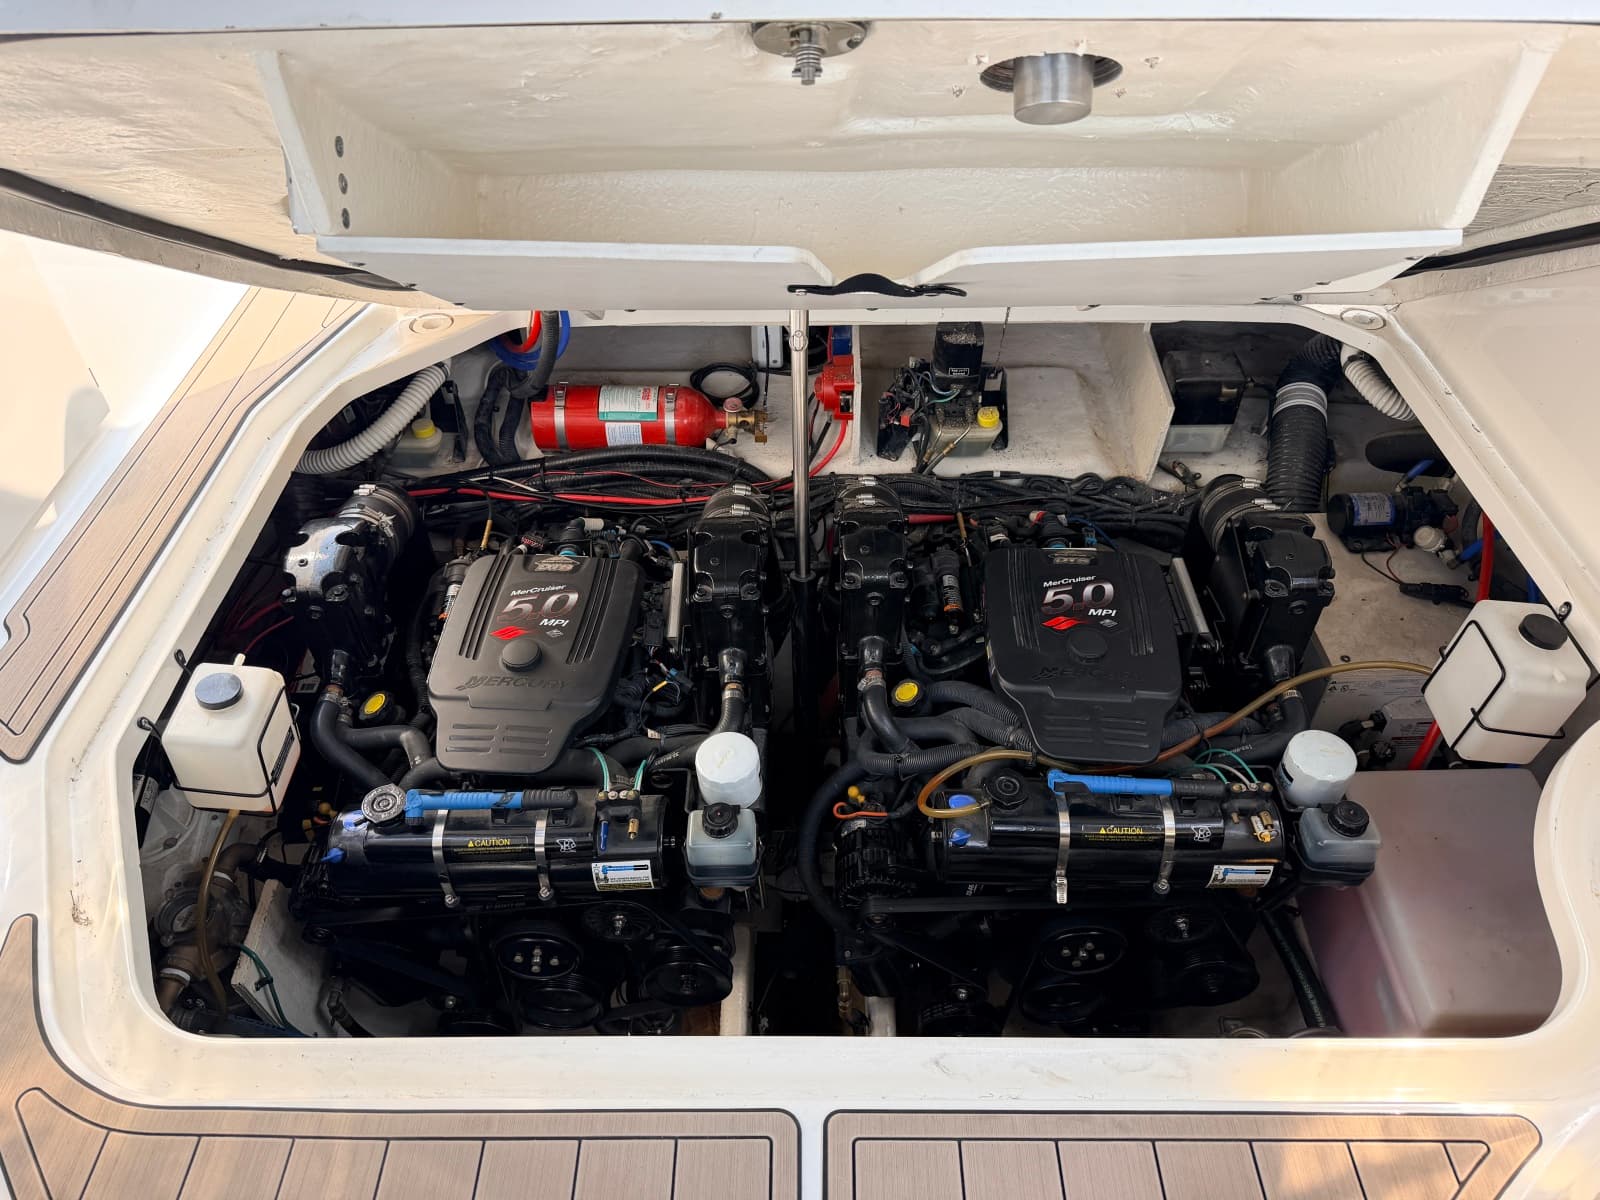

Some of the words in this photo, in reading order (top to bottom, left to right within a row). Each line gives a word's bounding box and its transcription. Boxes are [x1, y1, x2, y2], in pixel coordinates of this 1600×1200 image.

[1043, 575, 1096, 588] MerCruiser
[510, 584, 566, 596] MerCruiser
[1041, 582, 1115, 616] 5.0
[496, 590, 579, 624] 5.0
[1087, 608, 1117, 617] MPI
[539, 618, 570, 627] MPI
[474, 838, 511, 847] CAUTION
